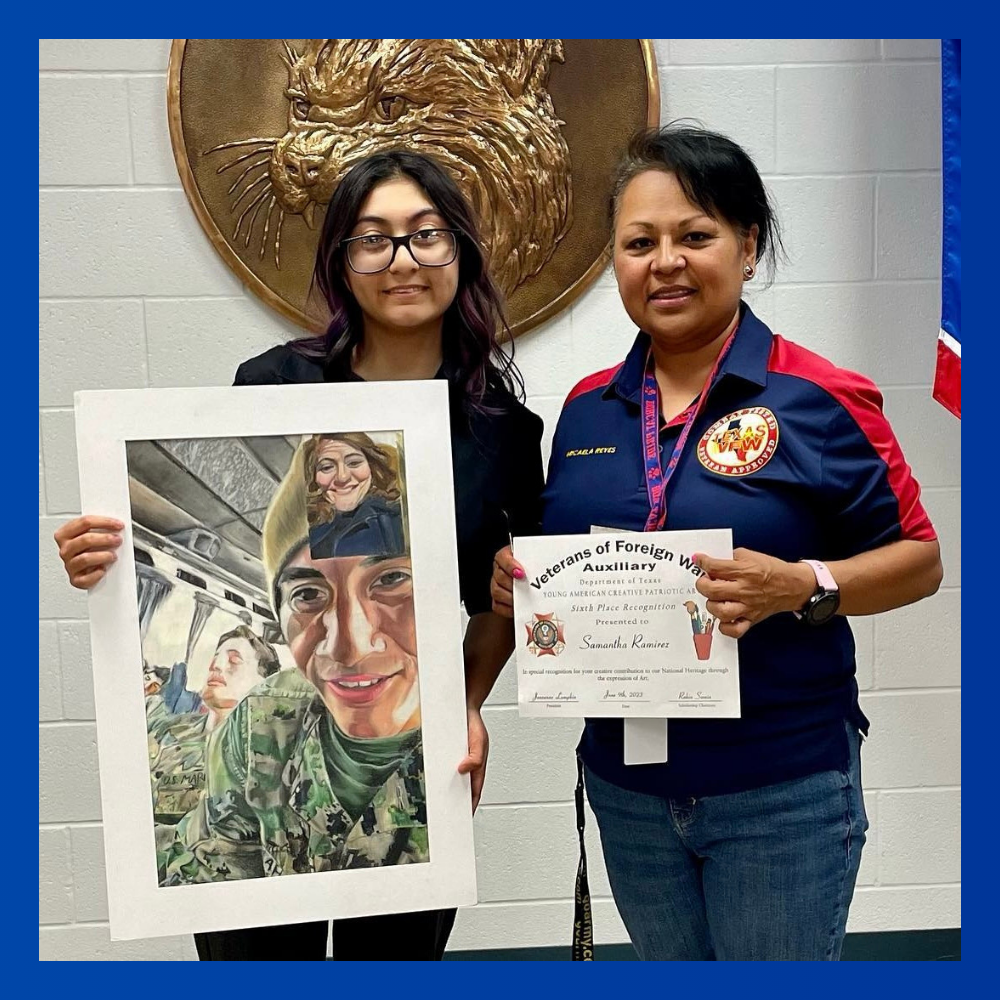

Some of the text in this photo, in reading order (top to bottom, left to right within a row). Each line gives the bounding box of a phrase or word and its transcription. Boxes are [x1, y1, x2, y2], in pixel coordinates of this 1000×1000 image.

[713, 424, 766, 443] TEXAS
[530, 540, 706, 590] Veterans of Foreign War
[583, 561, 657, 572] Auxiliary
[580, 578, 625, 587] Department
[570, 590, 606, 598] AMERICAN
[608, 589, 643, 597] CREATIVE
[645, 588, 684, 596] PATRIOTIC
[571, 603, 676, 612] Sixth Place Recognition
[579, 633, 670, 650] Samantha Ramirez
